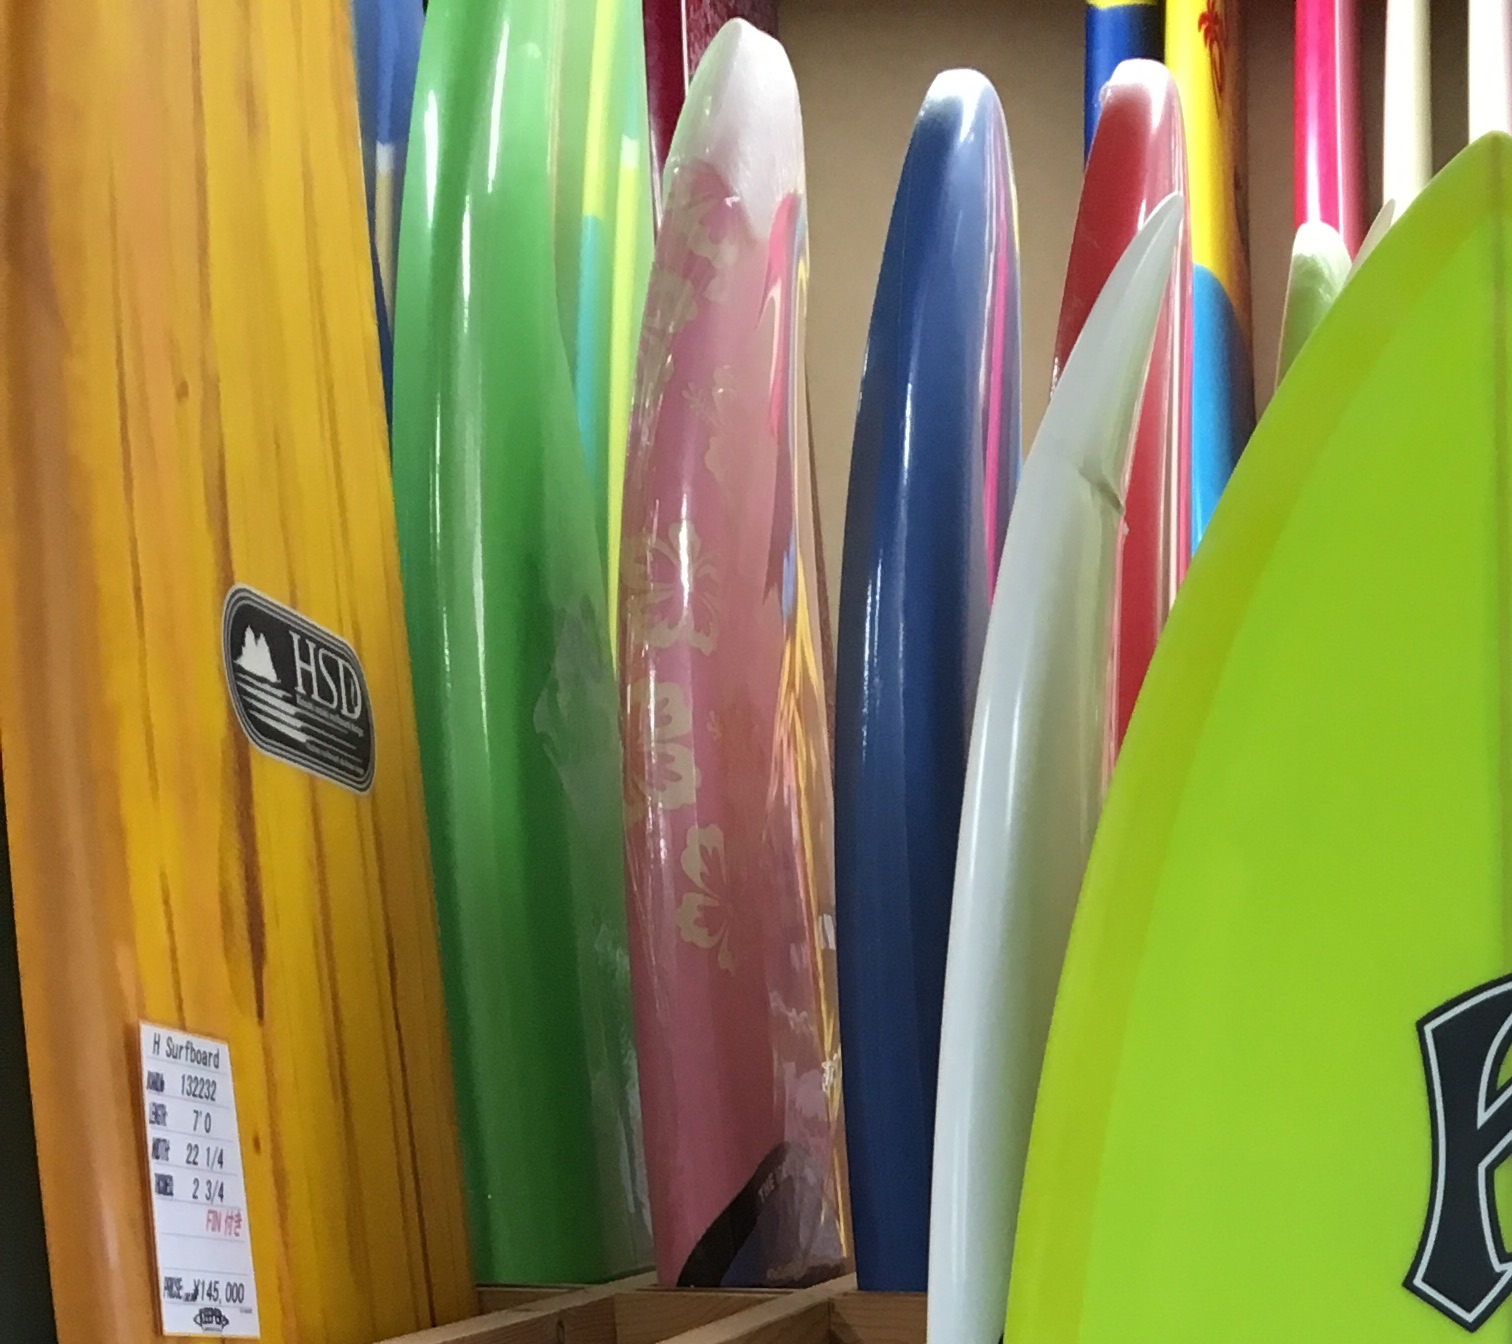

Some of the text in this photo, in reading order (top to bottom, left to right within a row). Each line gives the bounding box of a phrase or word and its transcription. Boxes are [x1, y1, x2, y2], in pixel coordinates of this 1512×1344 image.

[289, 630, 362, 719] HSD
[152, 1032, 220, 1069] H Surfboard
[181, 1073, 217, 1102] 132232
[185, 1142, 200, 1166] 22
[206, 1146, 224, 1170] 1/4
[192, 1177, 200, 1200] 2
[205, 1179, 224, 1203] 3/4
